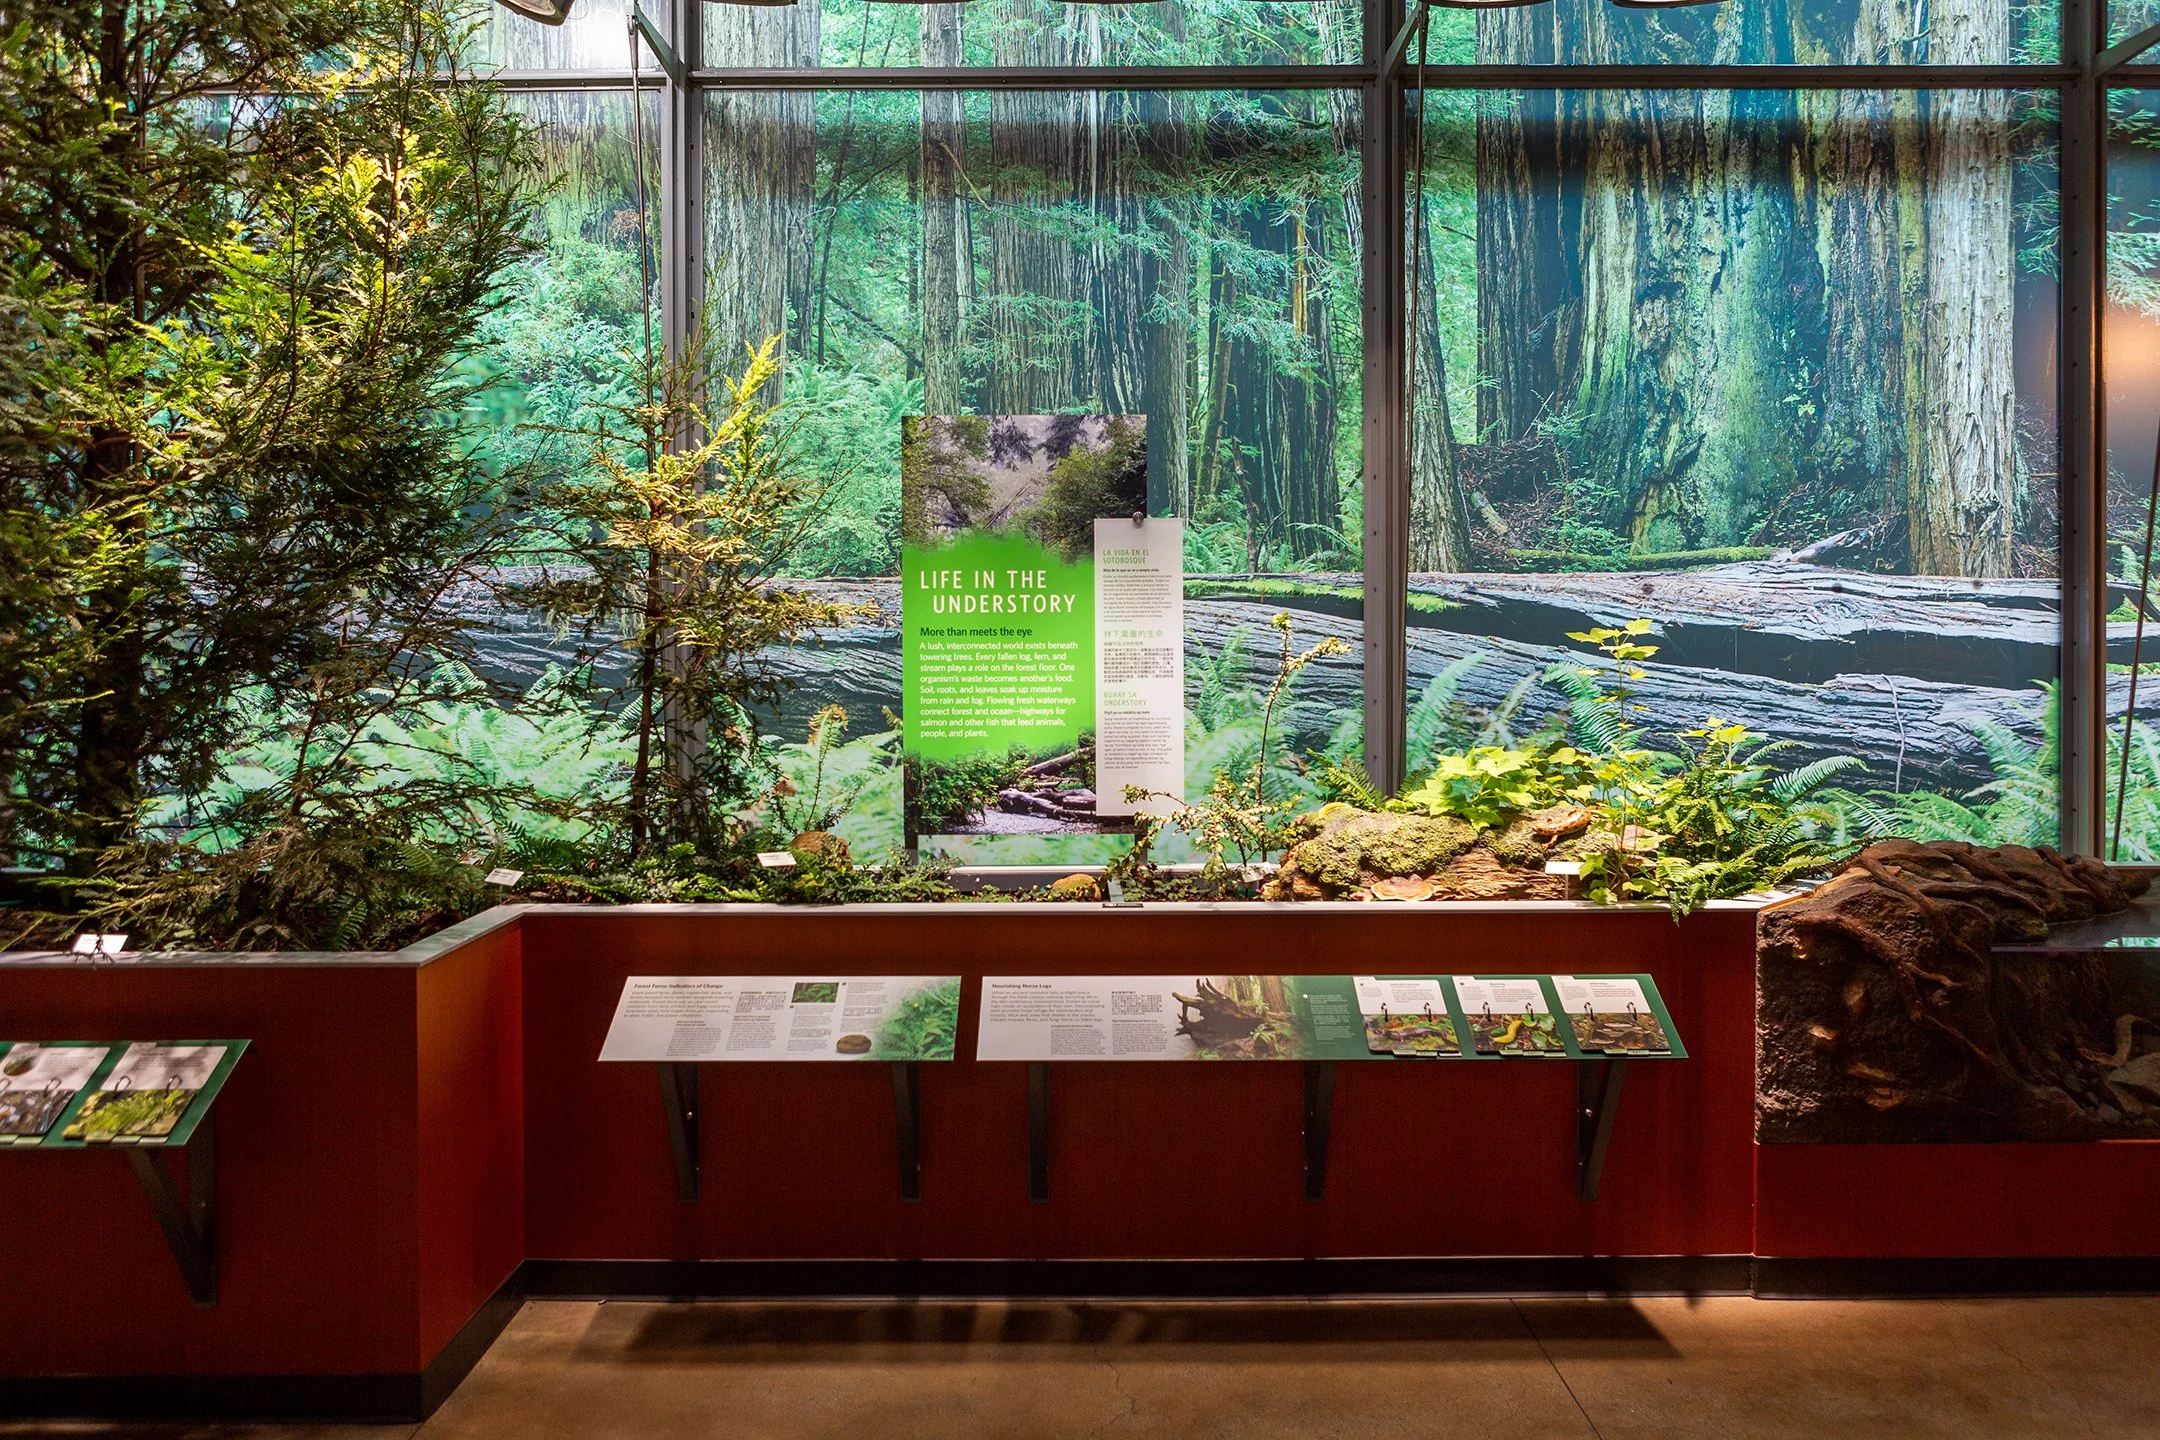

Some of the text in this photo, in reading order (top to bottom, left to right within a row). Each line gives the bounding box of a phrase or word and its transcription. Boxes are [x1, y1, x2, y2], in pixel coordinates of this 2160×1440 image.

[920, 570, 1047, 589] LIFE IN THE
[933, 594, 1076, 614] UNDERSTORY
[920, 626, 1032, 639] More than meets the eye
[919, 640, 1078, 651] A lush, interconnected world exists beneath
[920, 652, 1067, 663] towering trees. Every fallen log, fern, and
[920, 664, 946, 672] stream
[947, 664, 967, 673] plays
[974, 663, 989, 672] role
[1001, 663, 1015, 672] the
[1015, 663, 1037, 672] forest
[1038, 662, 1058, 671] floor.
[1058, 662, 1076, 672] One
[960, 675, 983, 683] waste
[984, 674, 1018, 682] becomes
[1054, 674, 1074, 682] food.
[920, 685, 1063, 695] Soil, roots, and leaves soak up moisture
[920, 696, 938, 704] from
[955, 696, 970, 704] and
[971, 696, 984, 706] fog.
[986, 696, 1015, 706] Flowing
[1016, 696, 1035, 704] fresh
[1036, 696, 1076, 706] waterways
[951, 707, 973, 715] forest
[974, 707, 989, 715] and
[1055, 706, 1066, 715] for
[948, 718, 963, 726] and
[964, 718, 984, 726] other
[986, 718, 1000, 726] fish
[1000, 718, 1016, 726] that
[1017, 718, 1035, 727] feed
[1035, 718, 1066, 727] animals,
[920, 729, 989, 739] people, and plants.
